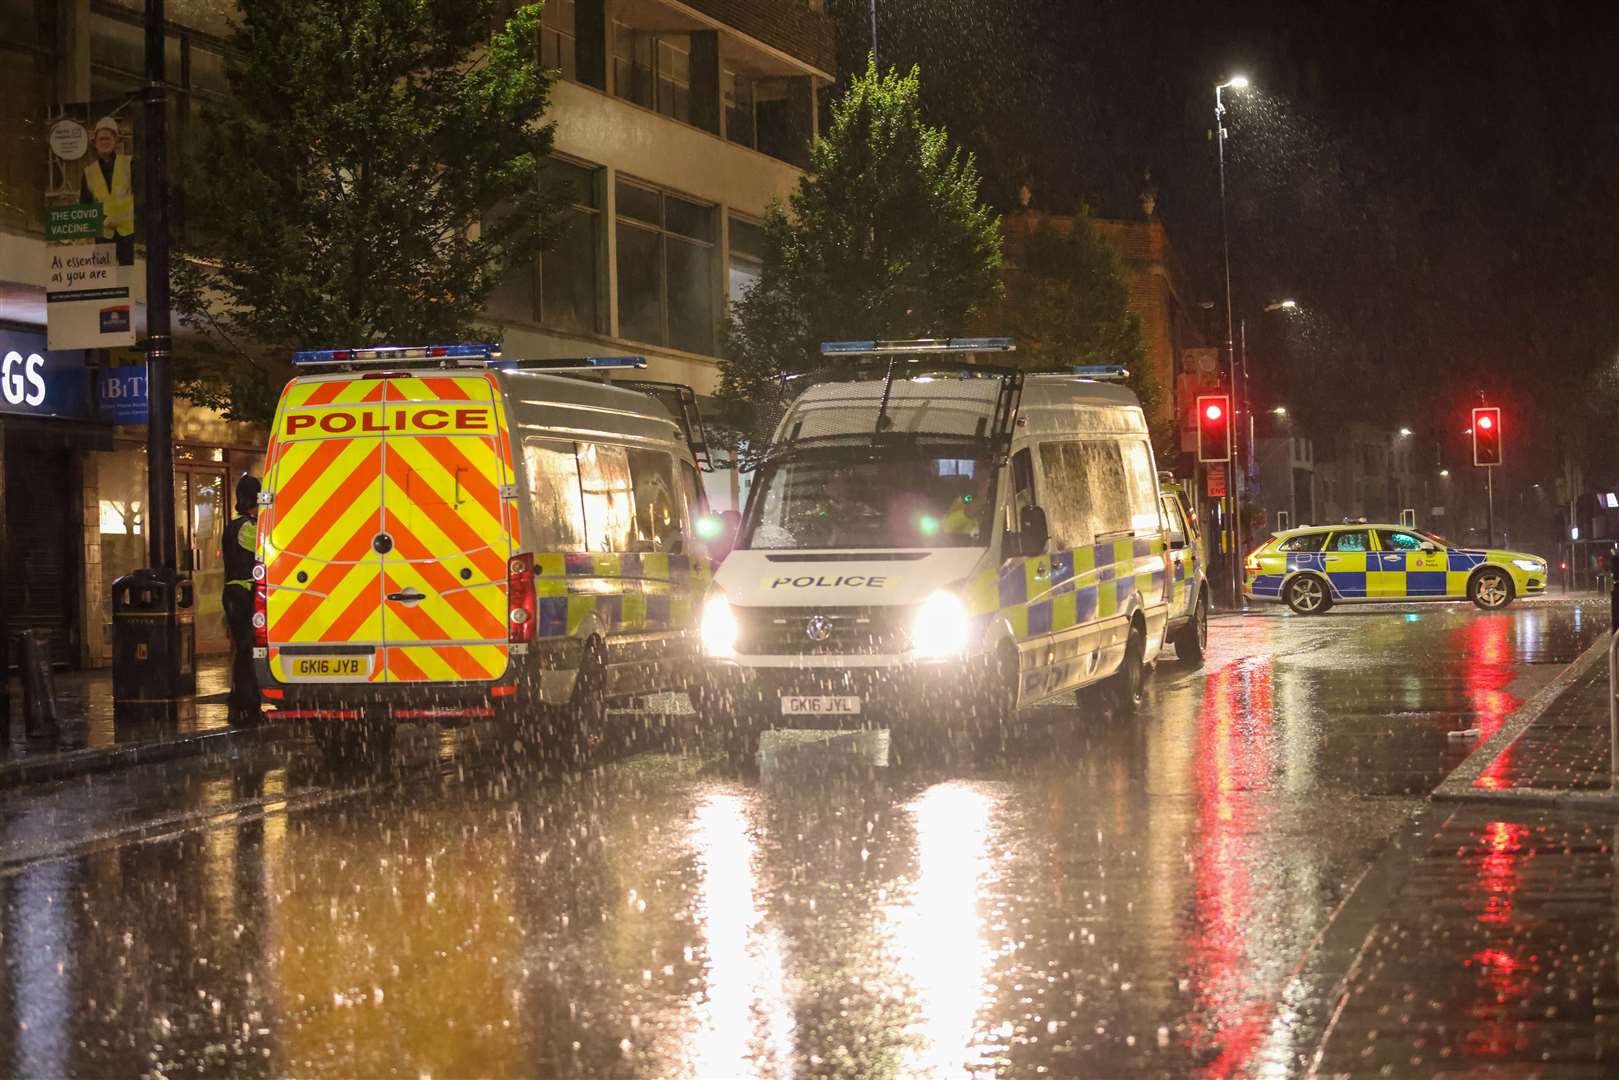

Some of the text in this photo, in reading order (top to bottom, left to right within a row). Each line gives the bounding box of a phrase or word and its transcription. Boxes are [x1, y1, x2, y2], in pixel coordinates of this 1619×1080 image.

[50, 208, 98, 221] THE COVID
[51, 252, 111, 269] As essential
[51, 269, 107, 286] as you are
[286, 409, 489, 435] POLICE
[771, 576, 887, 589] POLICE
[300, 660, 359, 674] GK16 JYB
[790, 698, 852, 712] GK16 JYL
